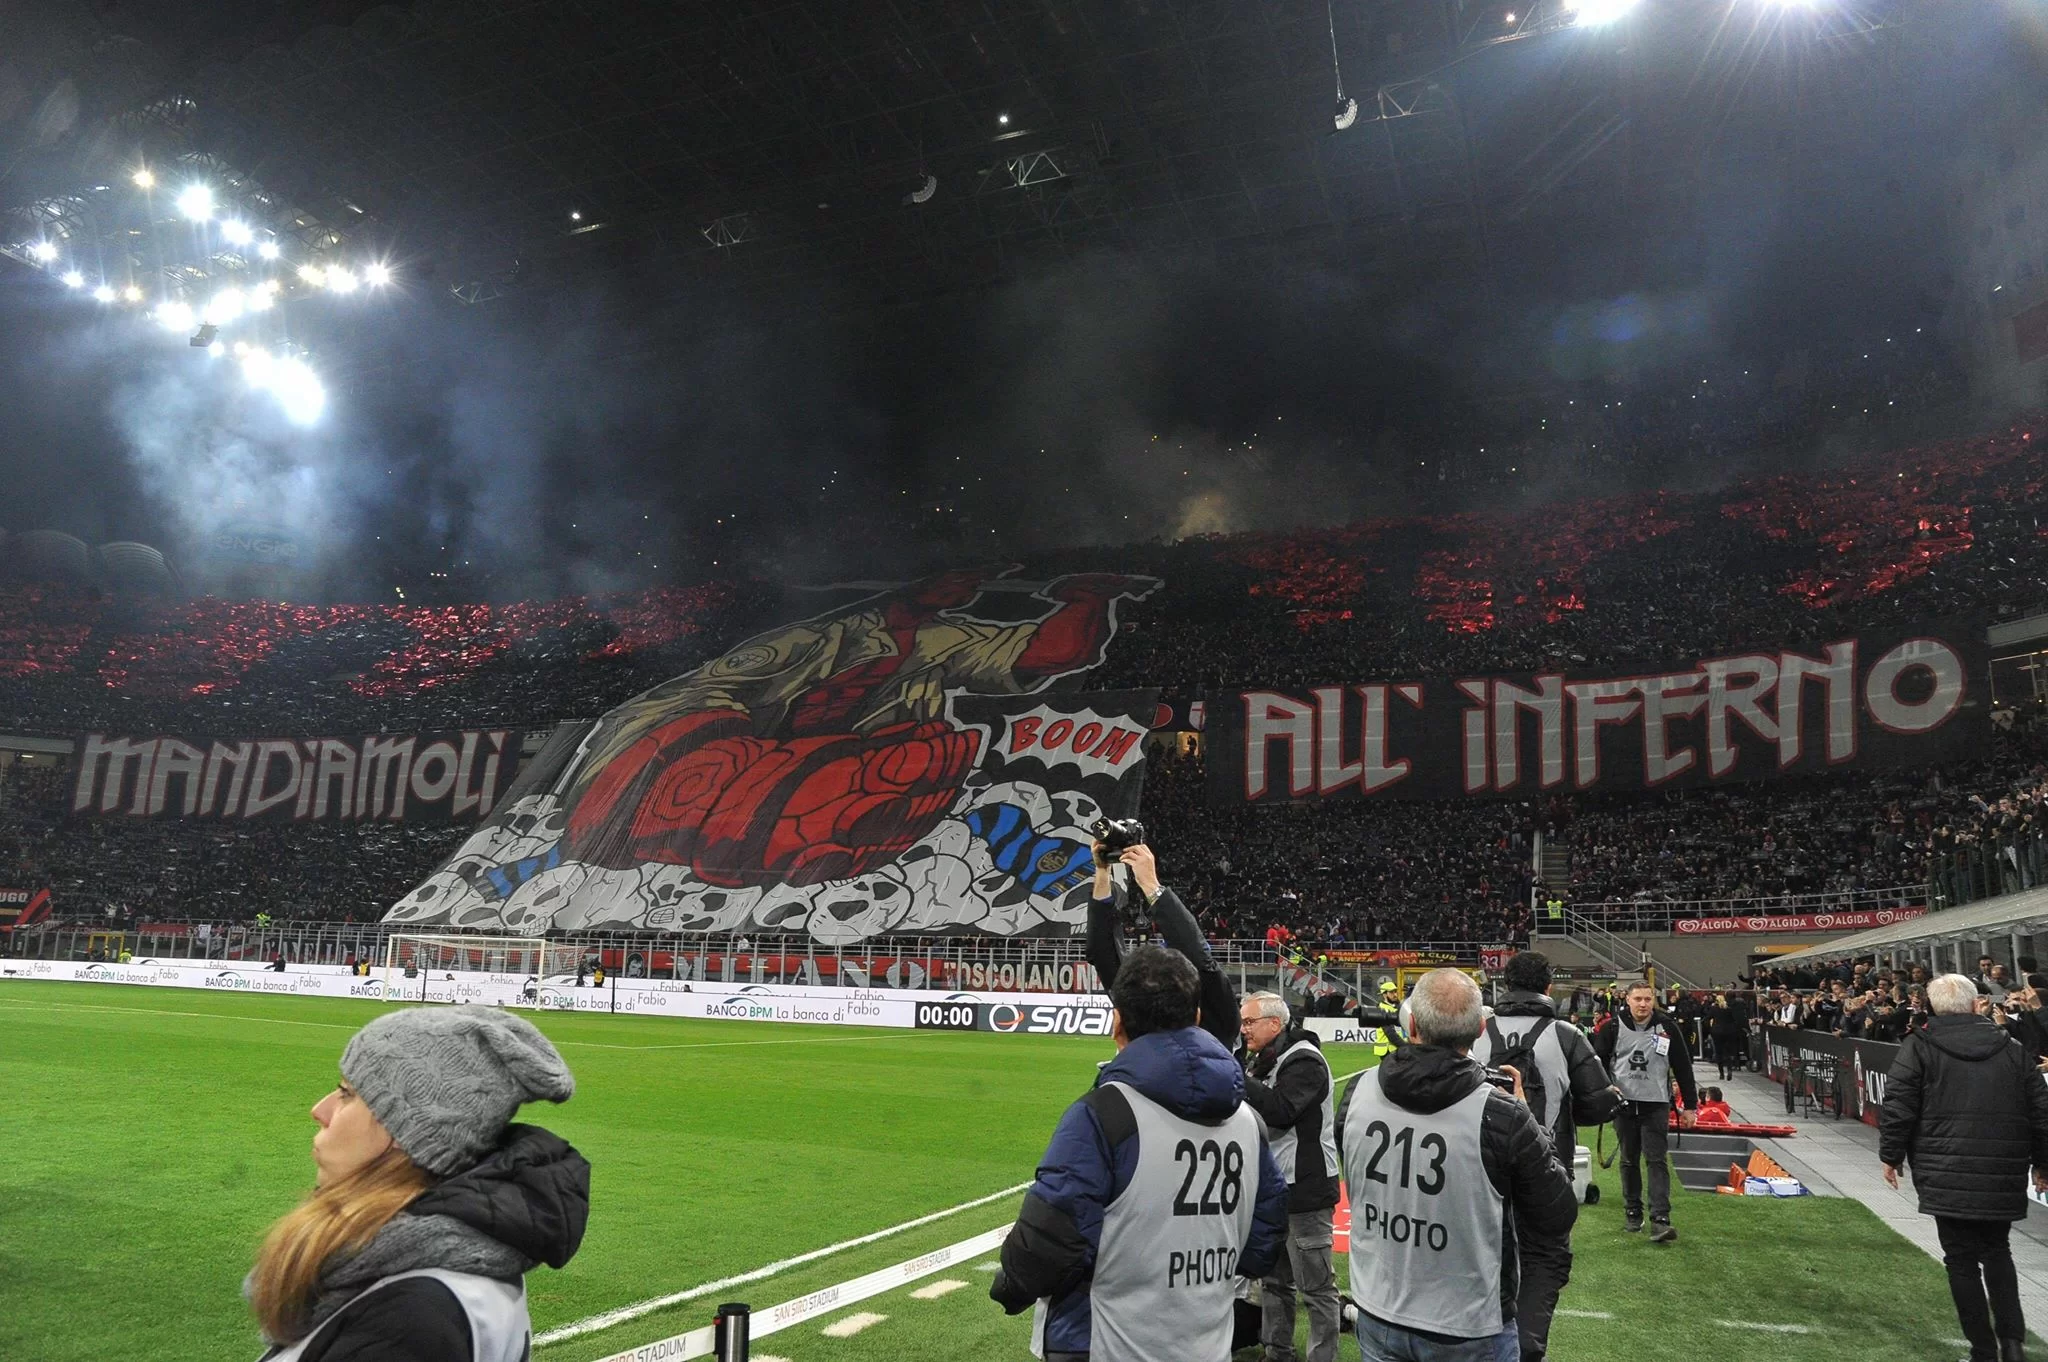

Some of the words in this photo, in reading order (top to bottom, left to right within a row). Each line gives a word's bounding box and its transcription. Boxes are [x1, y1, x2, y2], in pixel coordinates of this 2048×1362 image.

[1008, 716, 1141, 765] BOOM
[1701, 920, 1739, 930] ALGIDA
[1769, 917, 1807, 928] ALGIDA
[1835, 914, 1870, 924] ALGIDA
[1391, 952, 1425, 960] MILAN
[1428, 952, 1456, 960] CLUB
[75, 970, 100, 980] BANCO
[101, 971, 115, 981] BPM
[117, 971, 124, 981] La
[126, 972, 148, 983] banca
[150, 972, 157, 983] di
[159, 968, 179, 980] Fabio
[205, 977, 233, 988] BANCO
[234, 978, 250, 988] BPM
[252, 979, 261, 989] La
[263, 979, 287, 991] banca
[290, 980, 297, 991] di
[300, 976, 321, 988] Fabio
[350, 985, 380, 997] BANCO
[403, 987, 412, 999] La
[446, 989, 455, 1001] di
[456, 984, 481, 997] Fabio
[516, 995, 550, 1006] BANO
[576, 995, 586, 1007] La
[626, 998, 635, 1010] di
[638, 992, 666, 1006] Fabio
[706, 1004, 747, 1017] BANCO
[749, 1006, 772, 1018] BPM
[776, 1006, 789, 1019] La
[793, 1007, 828, 1021] banca
[833, 1007, 844, 1021] di
[847, 1002, 880, 1016] Fabio
[919, 1006, 973, 1026] 00:00
[1335, 1029, 1377, 1042] BANC
[1364, 1120, 1447, 1195] 213
[1172, 1138, 1243, 1216] 228
[1365, 1203, 1448, 1251] PHOTO
[1168, 1246, 1236, 1288] PHOTO
[774, 1303, 791, 1323] SAN
[792, 1298, 808, 1317] SIRO
[809, 1287, 839, 1310] STADIUM
[637, 1336, 687, 1362] STADIUM
